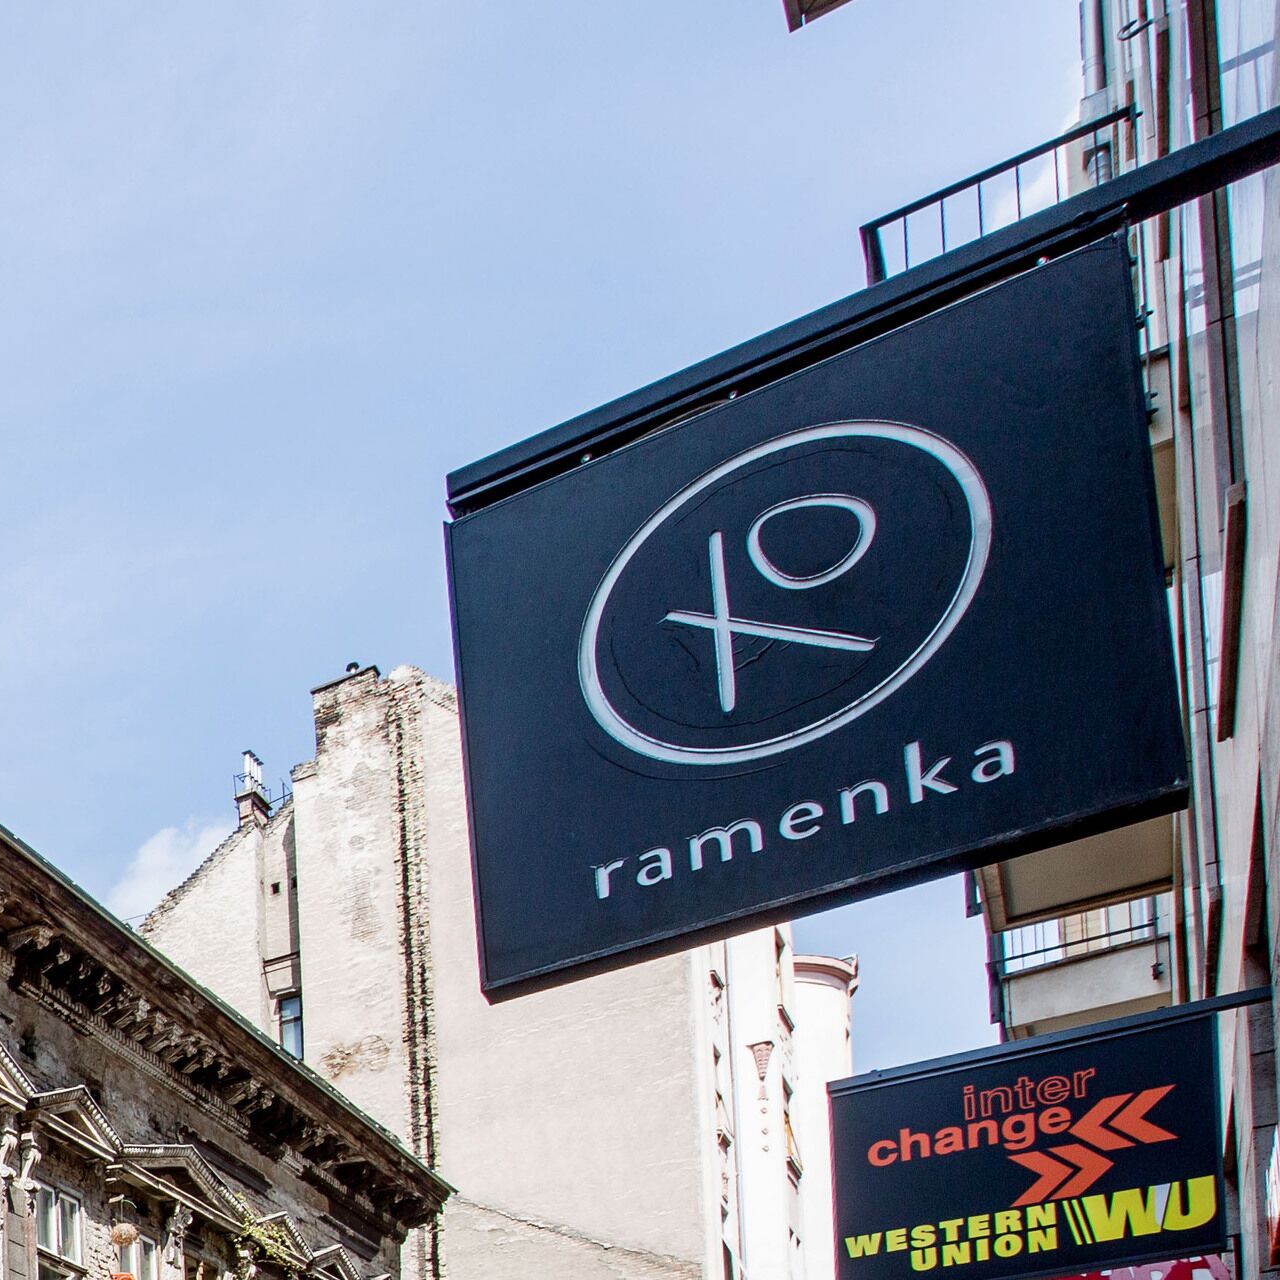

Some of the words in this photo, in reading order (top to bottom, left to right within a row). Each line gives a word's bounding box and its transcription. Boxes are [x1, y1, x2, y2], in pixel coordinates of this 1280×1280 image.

[589, 737, 1017, 900] ramenka
[962, 1066, 1097, 1121] inter
[867, 1105, 1073, 1168] change
[844, 1201, 1059, 1260] WESTERN
[1081, 1174, 1216, 1244] WU
[909, 1226, 1059, 1273] UNION
